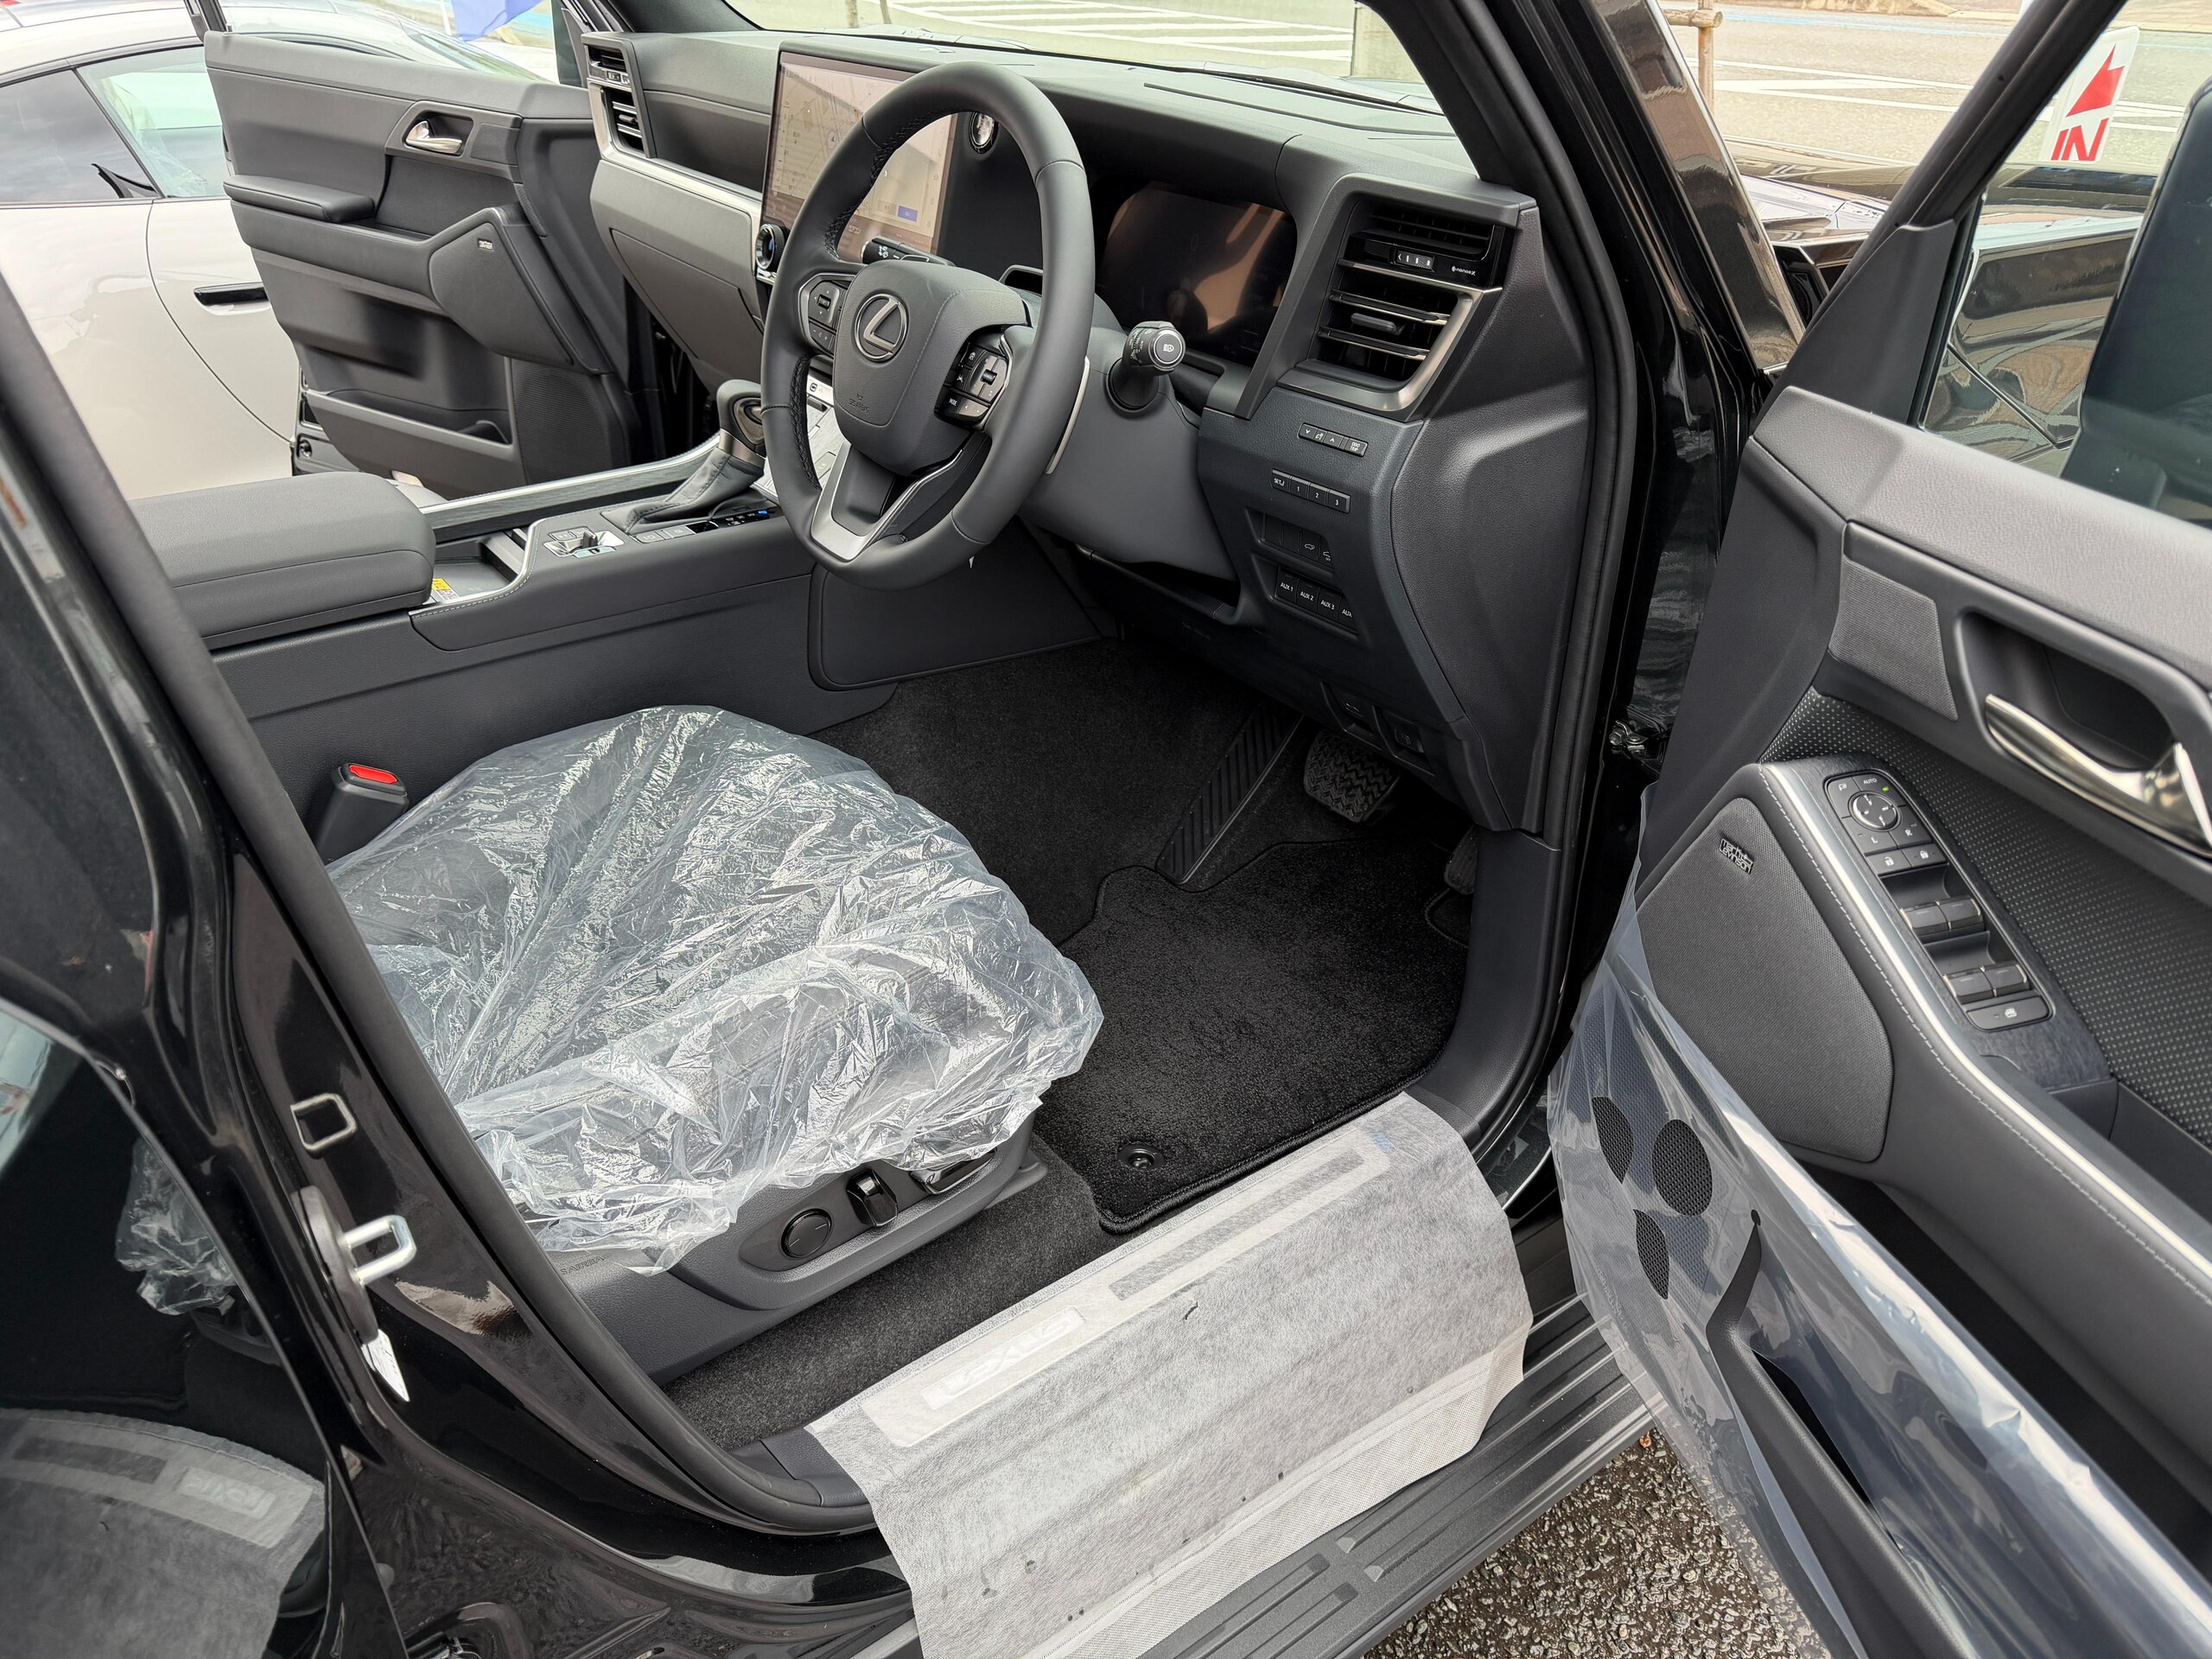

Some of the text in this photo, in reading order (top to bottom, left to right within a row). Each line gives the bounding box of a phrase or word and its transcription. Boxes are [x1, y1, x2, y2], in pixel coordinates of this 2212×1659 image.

[2050, 118, 2109, 161] IN
[1280, 582, 1290, 591] AUX
[1300, 591, 1310, 600] AUX
[1320, 600, 1331, 608] AUX
[1341, 609, 1352, 618] AUX
